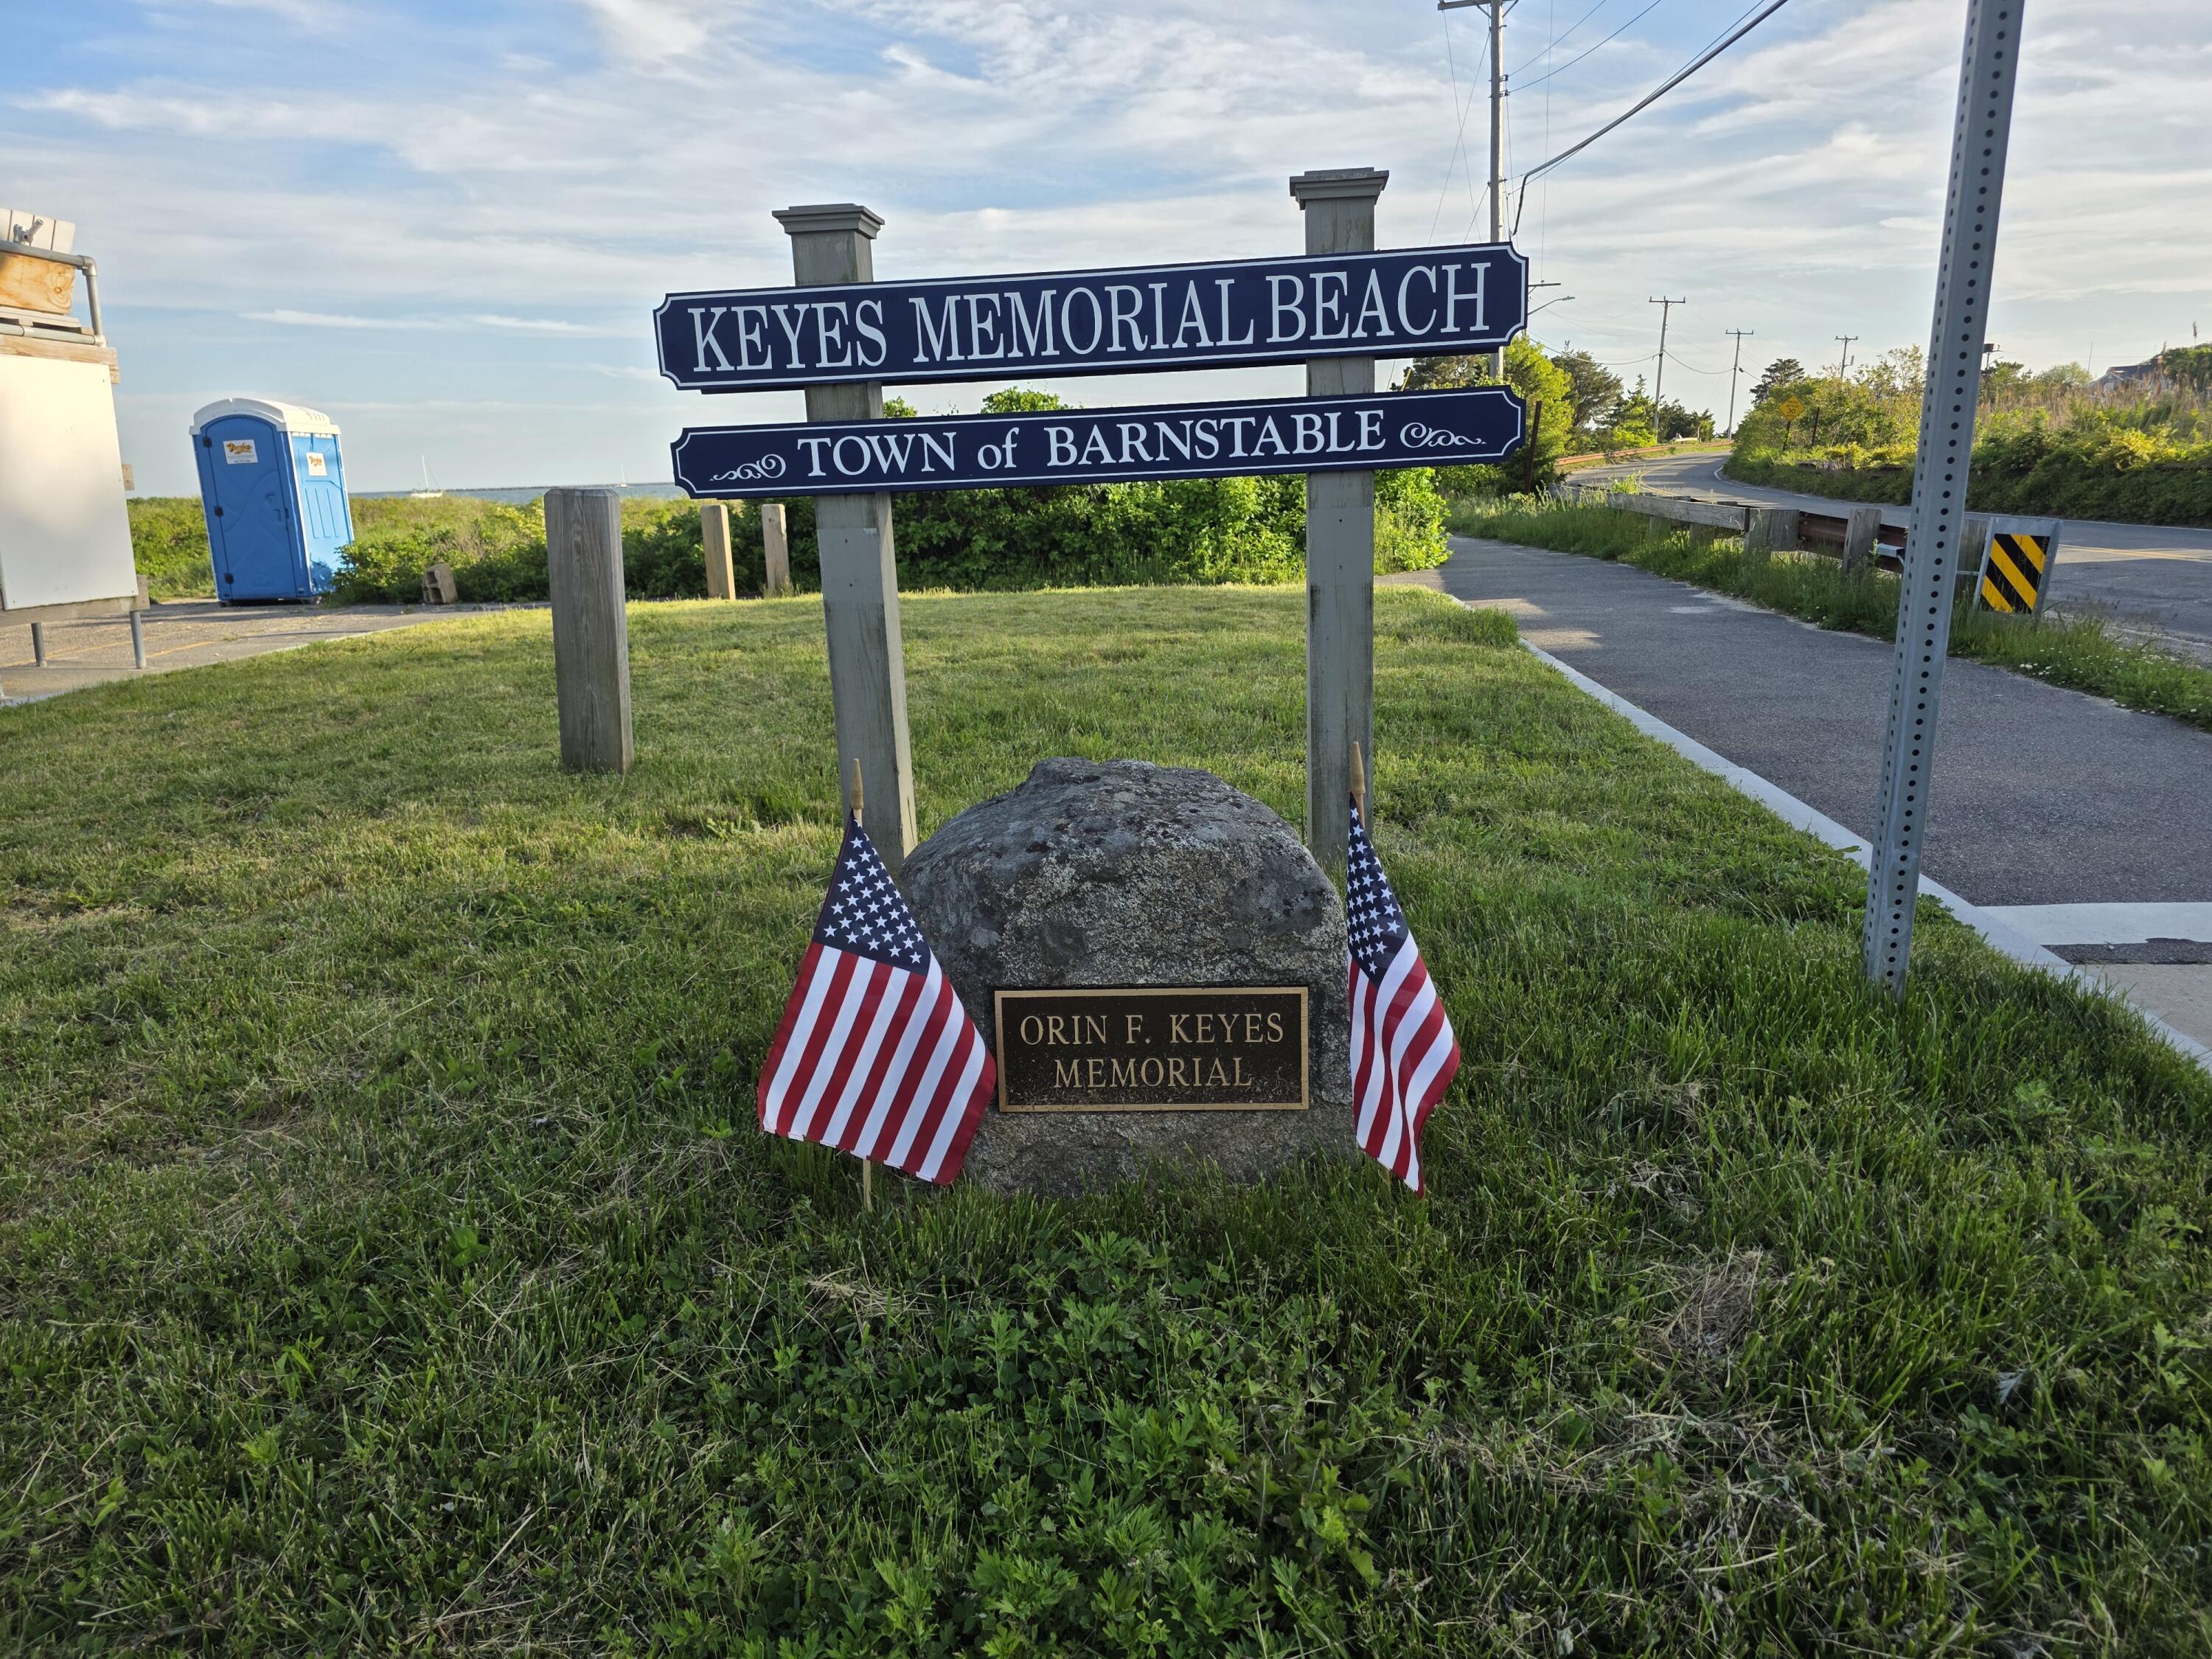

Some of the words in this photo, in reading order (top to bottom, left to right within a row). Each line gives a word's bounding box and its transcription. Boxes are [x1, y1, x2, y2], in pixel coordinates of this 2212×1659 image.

[687, 299, 886, 373] KEYES
[908, 278, 1254, 364] MEMORIAL
[1265, 262, 1492, 344] BEACH
[797, 431, 957, 478] TOWN
[977, 427, 1020, 470] of
[1044, 409, 1387, 467] BARNSTABLE
[1020, 1015, 1108, 1046] ORIN
[1125, 1014, 1151, 1045] F.
[1169, 1012, 1284, 1044] KEYES
[1053, 1057, 1253, 1088] MEMORIAL
